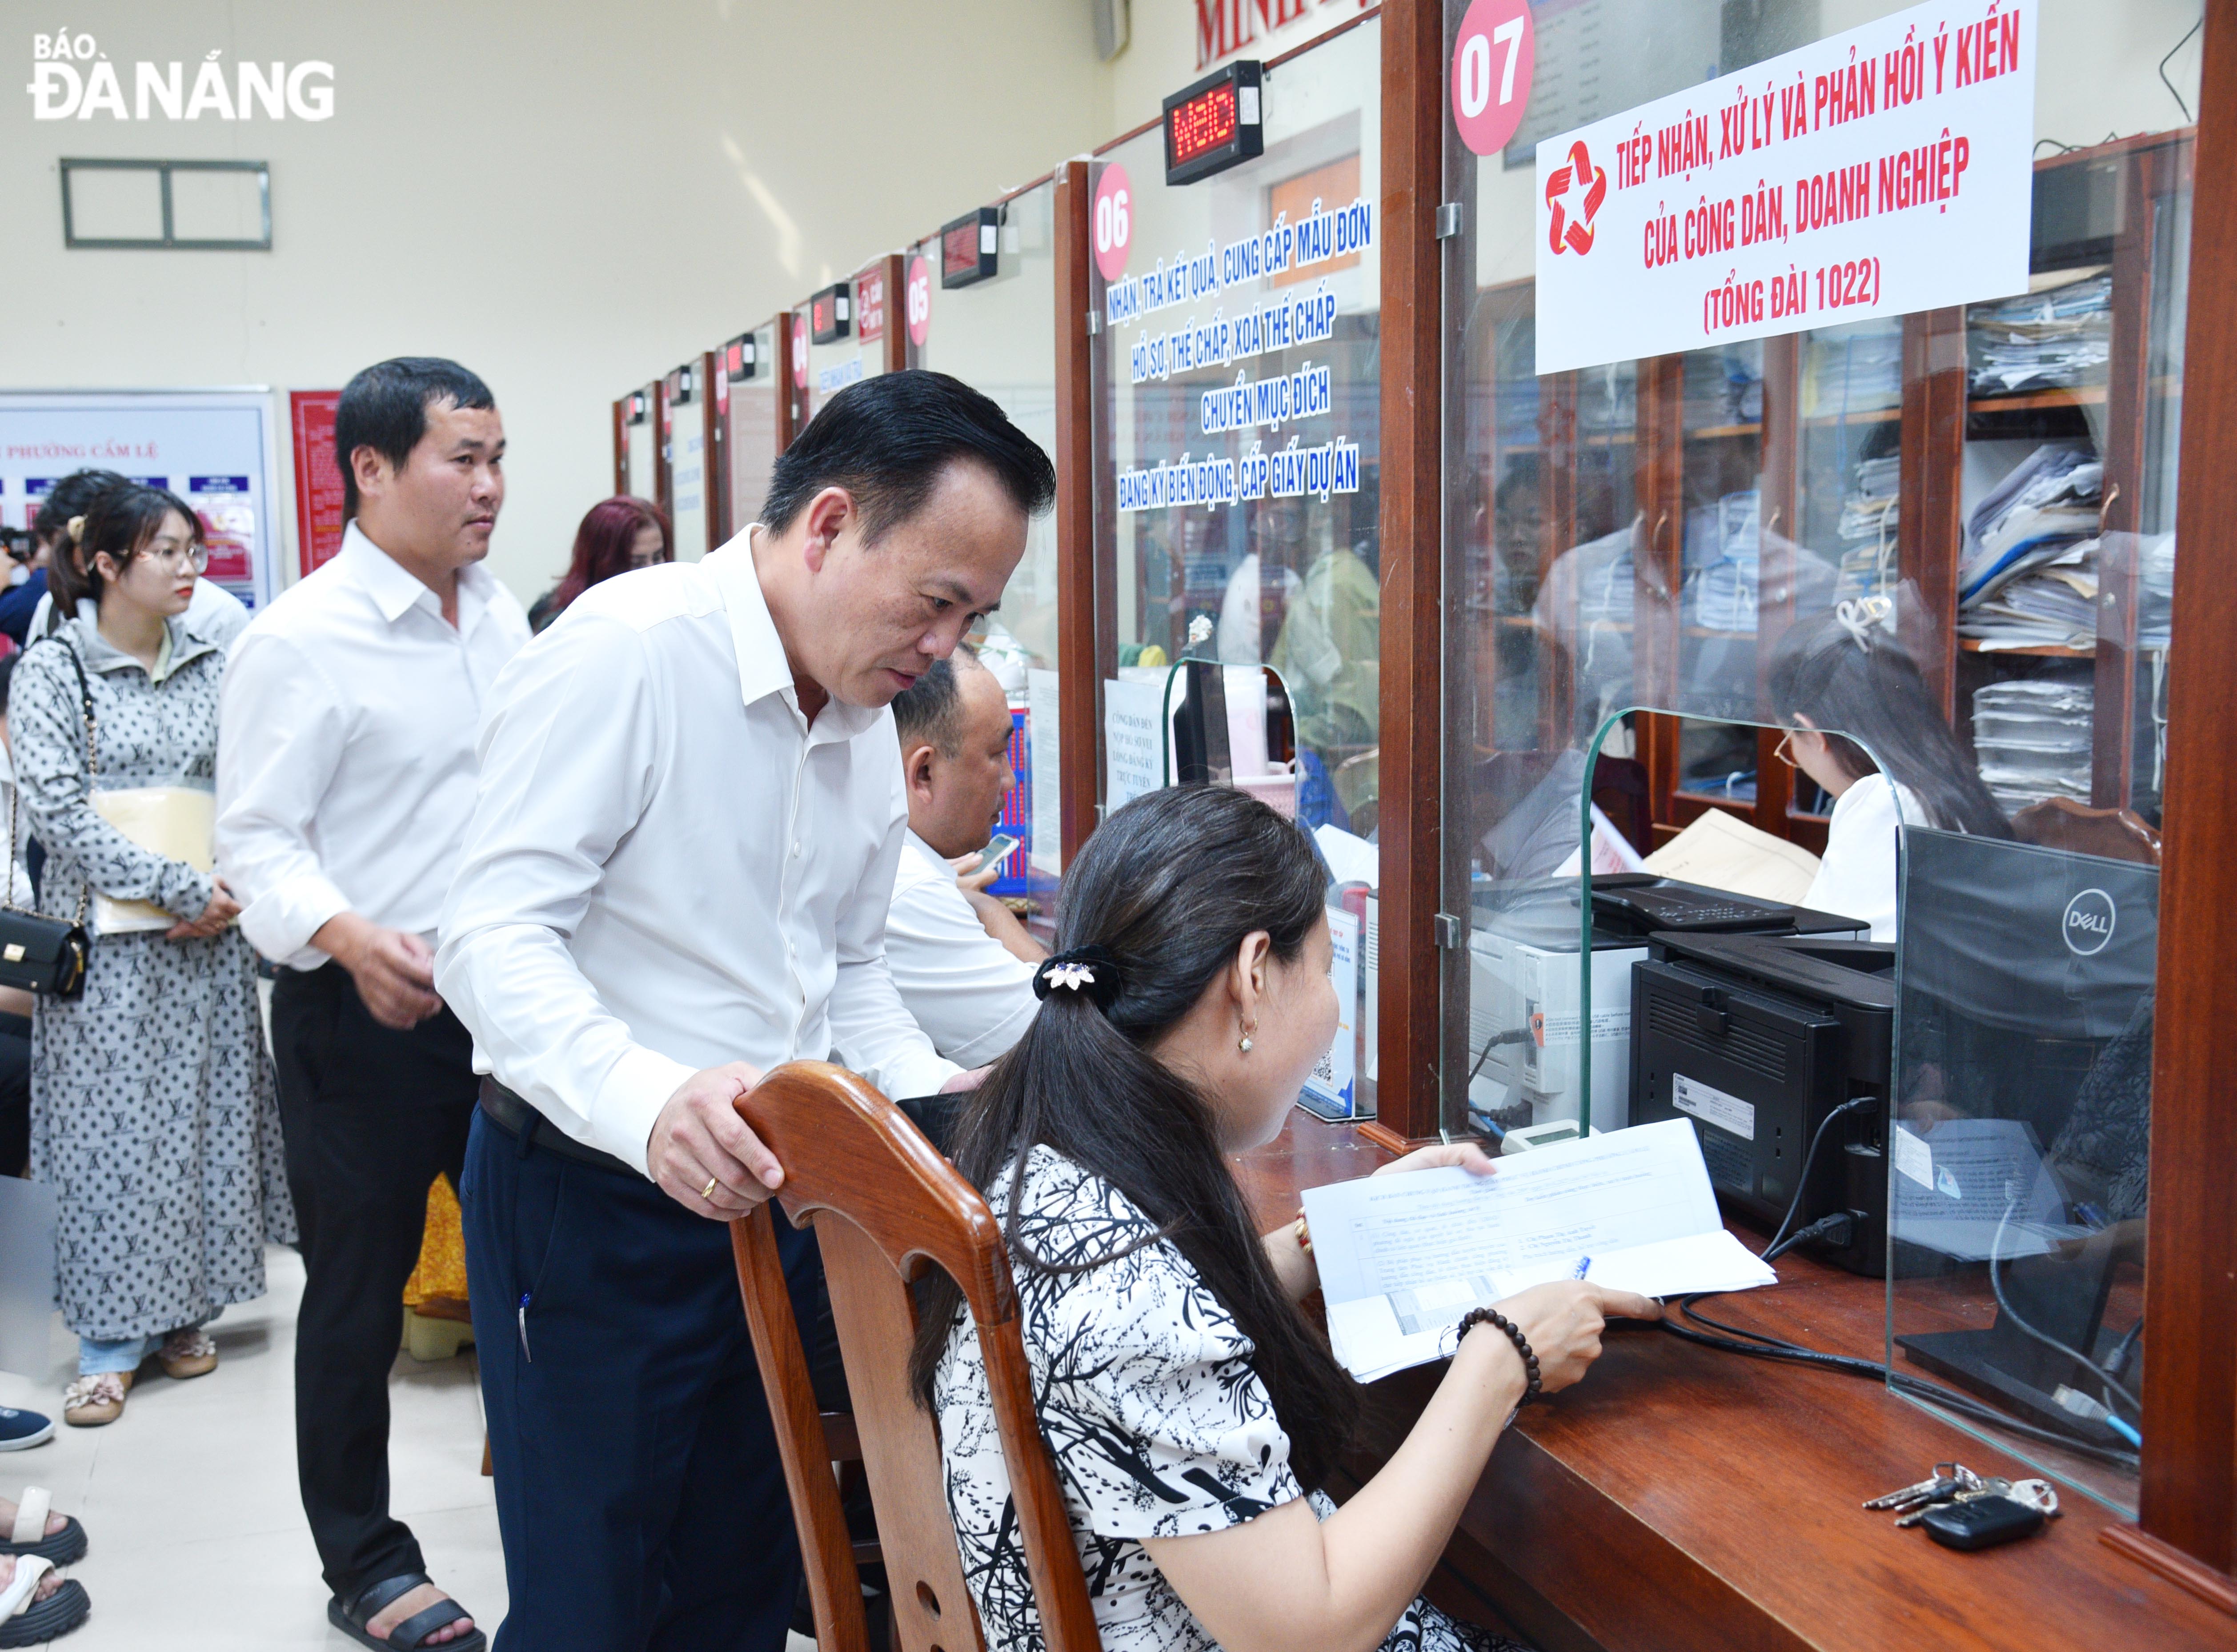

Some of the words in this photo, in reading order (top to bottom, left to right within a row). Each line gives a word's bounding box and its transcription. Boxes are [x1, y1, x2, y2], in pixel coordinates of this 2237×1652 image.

[1460, 15, 1524, 119] 07
[1616, 120, 1652, 190] TIẾP
[1658, 109, 1713, 182] NHẬN,
[1720, 84, 1748, 160] XỬ
[1752, 80, 1775, 150] LÝ
[1781, 70, 1807, 141] VÀ
[1814, 45, 1876, 131] PHẢN
[1884, 24, 1924, 111] HỒI
[1933, 20, 1948, 95] Ý
[1955, 0, 2020, 89] KIẾN
[1097, 197, 1129, 254] 06
[1644, 200, 1679, 269] CỦA
[1684, 195, 1735, 259] CÔNG
[1741, 179, 1788, 245] DÂN,
[1796, 161, 1871, 234] DOANH
[1877, 127, 1969, 215] NGHIỆP
[908, 277, 929, 325] 05
[1108, 277, 1142, 326] NHẬN,
[1143, 262, 1164, 310] TRẢ
[1167, 253, 1188, 304] KẾT
[1191, 241, 1219, 299] QUẢ,
[1224, 237, 1259, 285] CUNG
[1264, 216, 1292, 273] CẤP
[1297, 203, 1331, 263] MẪU
[1337, 202, 1371, 253] ĐƠN
[1704, 268, 1764, 335] (TỔNG
[1771, 263, 1807, 319] ĐÀI
[1816, 256, 1880, 308] 1022)
[1150, 336, 1167, 377] SƠ,
[1171, 318, 1192, 370] THẾ
[1196, 309, 1230, 365] CHẤP,
[1234, 305, 1261, 356] XOÁ
[1264, 292, 1290, 348] THẾ
[1295, 279, 1335, 341] CHẤP
[1203, 371, 1253, 430] CHUYỂN
[1257, 379, 1288, 428] MỤC
[1293, 364, 1328, 416] ĐÍCH
[1120, 468, 1148, 509] ĐĂNG
[1151, 461, 1165, 505] KÝ
[1169, 454, 1195, 503] BIẾN
[1199, 456, 1238, 509] ĐỘNG,
[1241, 443, 1267, 497] CẤP
[1272, 439, 1305, 493] GIẤY
[1310, 446, 1331, 501] DỰ
[1335, 439, 1356, 489] ÁN
[2069, 911, 2108, 933] DELL
